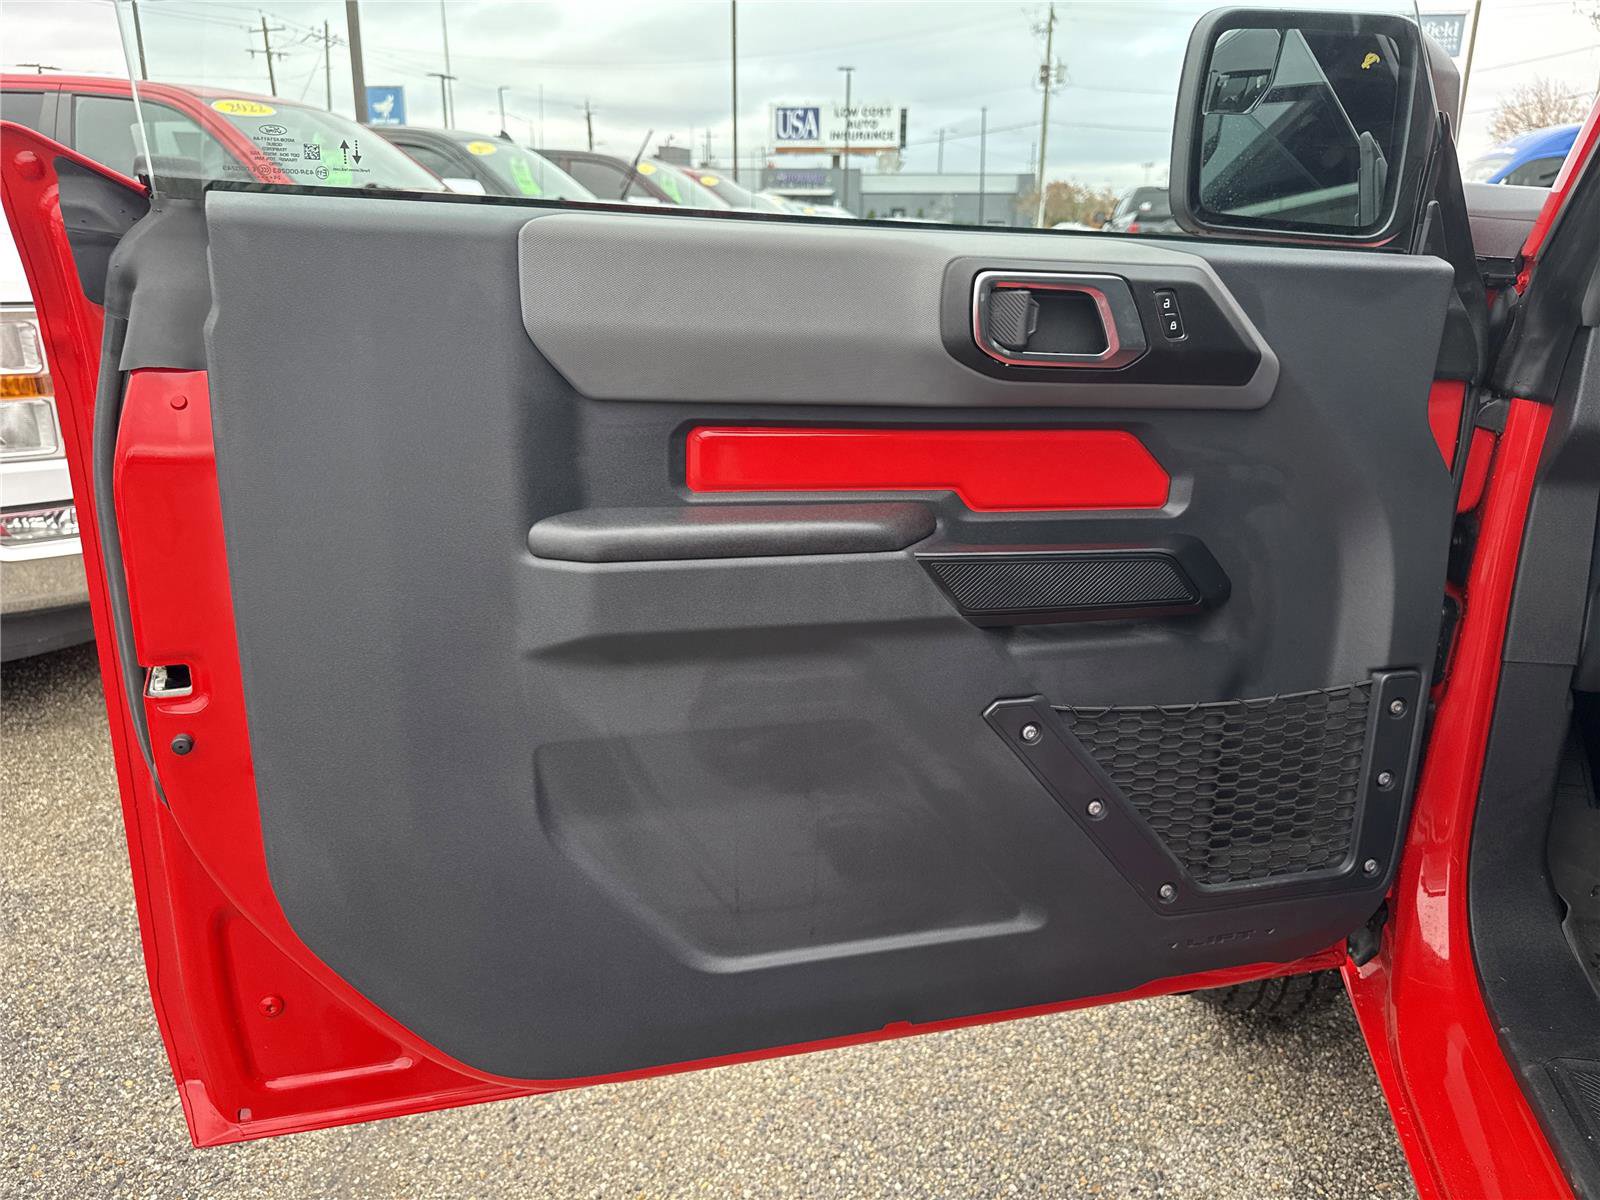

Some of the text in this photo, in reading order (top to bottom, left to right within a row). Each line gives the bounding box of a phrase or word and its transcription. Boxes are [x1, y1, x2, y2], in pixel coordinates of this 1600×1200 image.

[834, 108, 892, 118] LOW COST
[776, 108, 819, 139] USA
[846, 120, 879, 129] AUTO
[830, 131, 896, 141] INSURANCE
